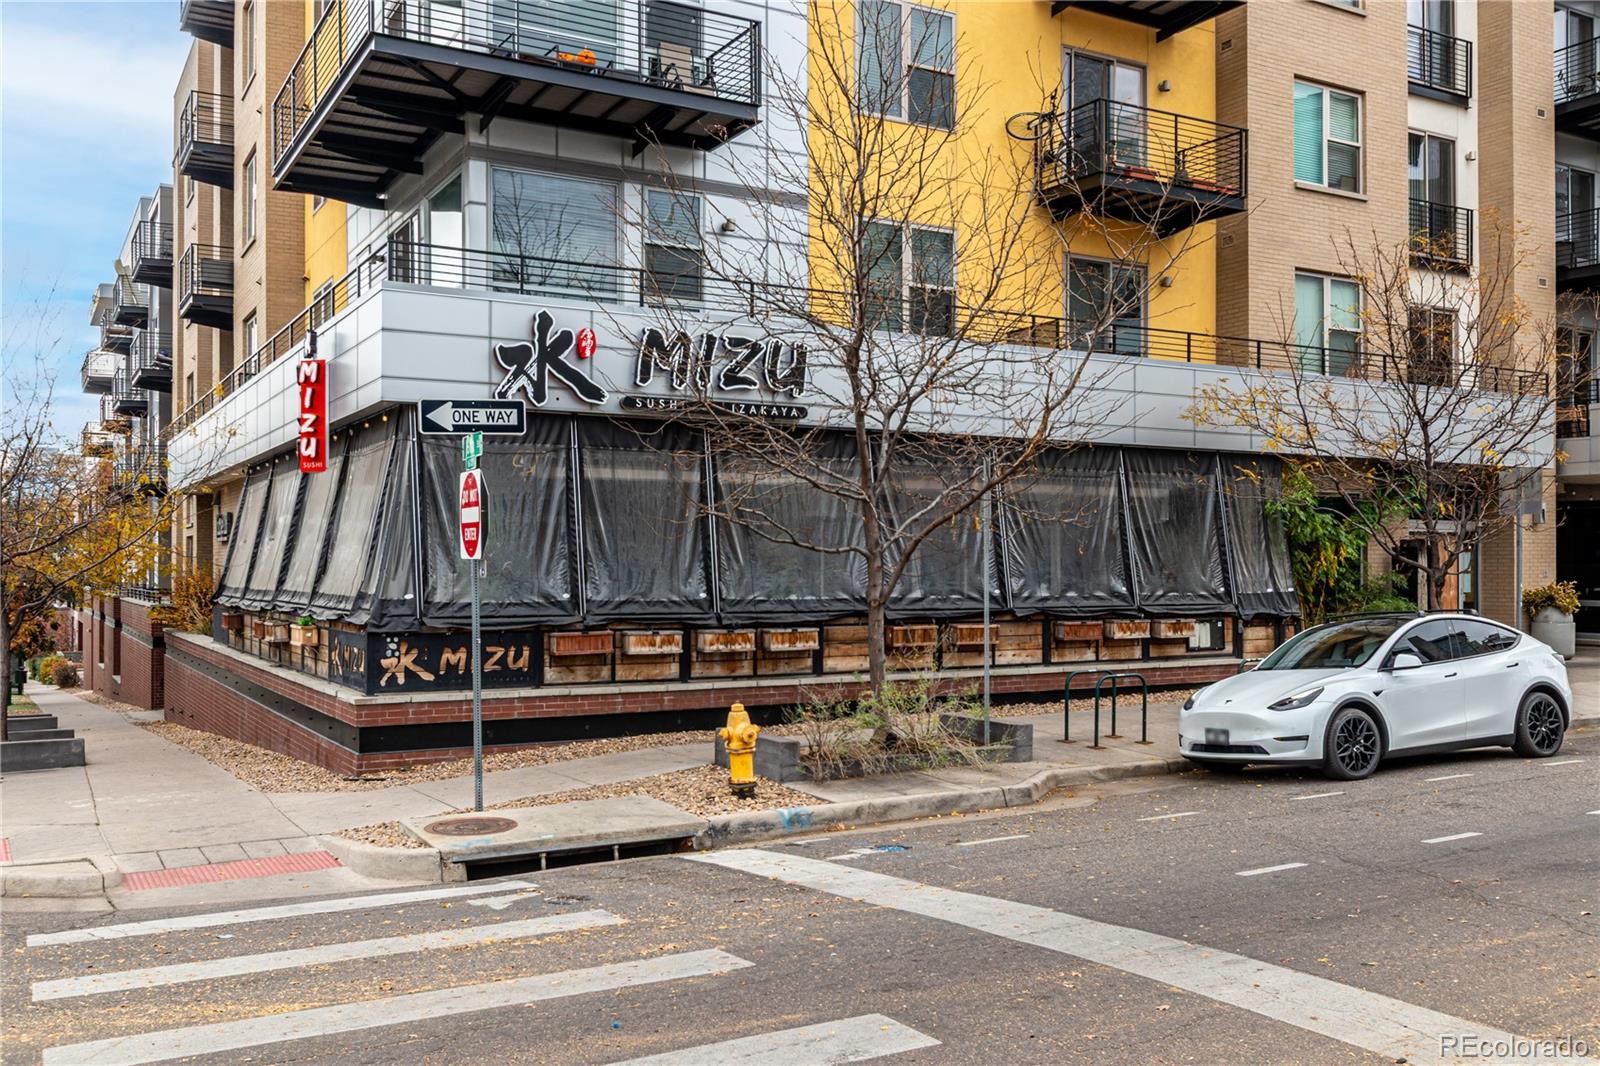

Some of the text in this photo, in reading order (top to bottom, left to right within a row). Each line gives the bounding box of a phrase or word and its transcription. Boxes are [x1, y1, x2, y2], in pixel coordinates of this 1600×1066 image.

[495, 307, 609, 407] 水
[635, 326, 808, 398] MIZU
[299, 361, 318, 458] MIZU
[452, 410, 513, 423] ONE WAY
[635, 399, 798, 417] SUSH IZAKAYA
[462, 488, 478, 504] DO NOT
[464, 527, 477, 541] ENTER
[439, 645, 530, 675] MZU
